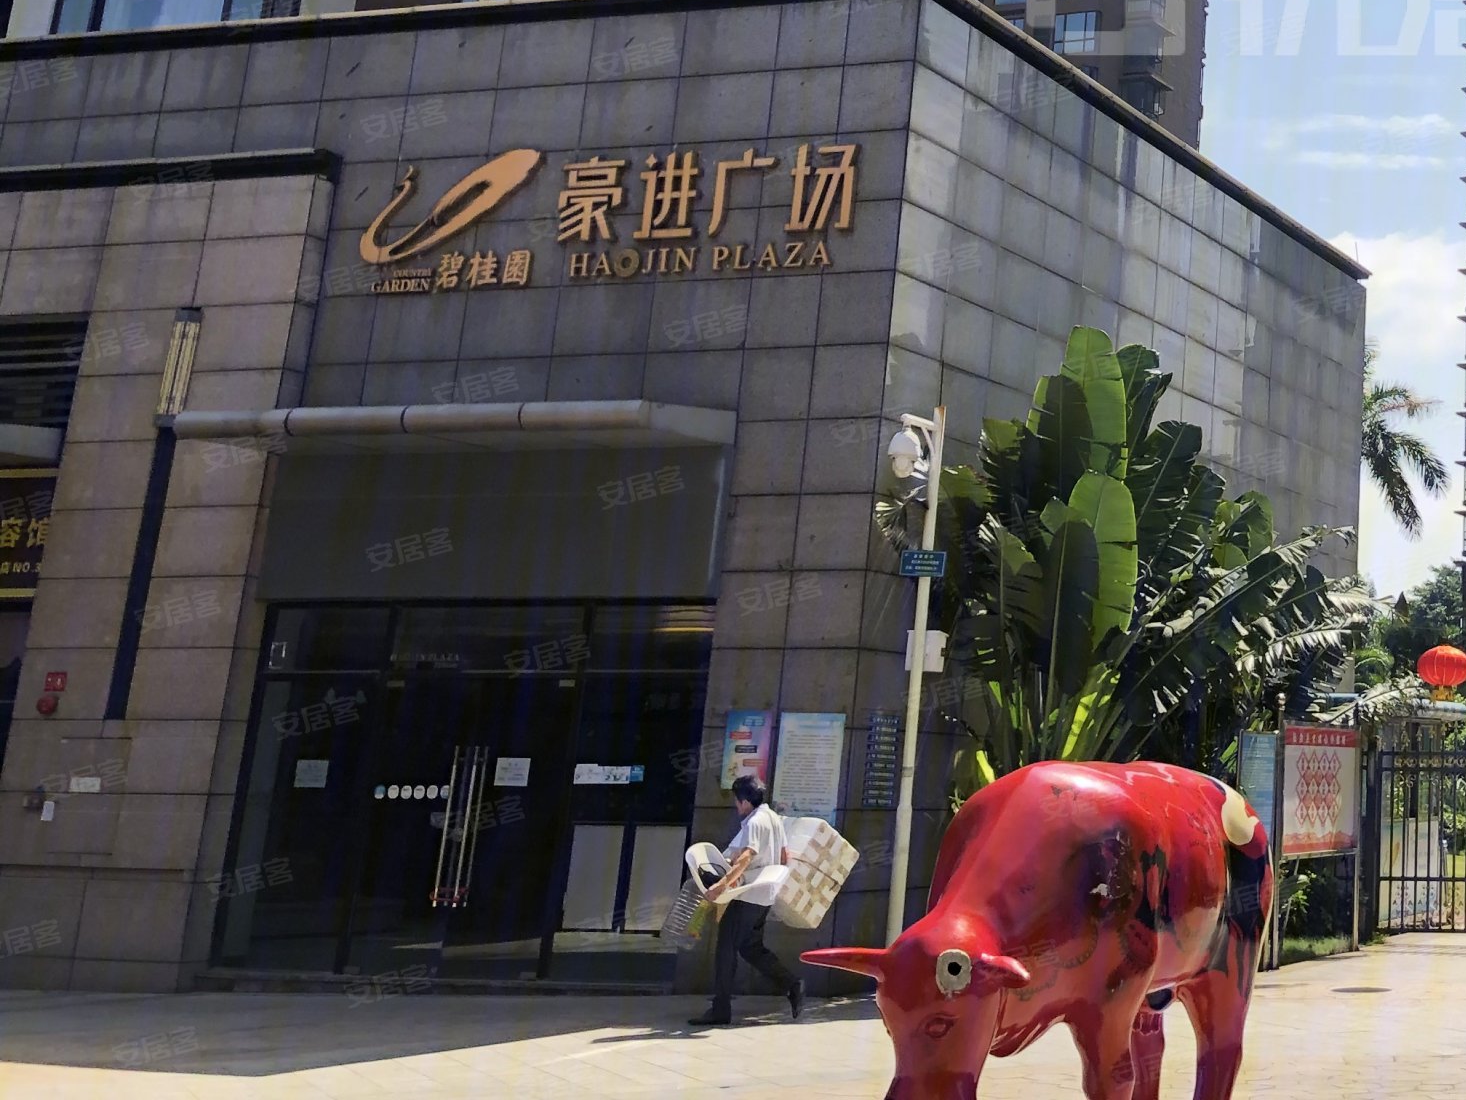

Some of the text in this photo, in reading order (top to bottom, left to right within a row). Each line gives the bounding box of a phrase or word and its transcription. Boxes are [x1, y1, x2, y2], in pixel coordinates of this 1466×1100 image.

[557, 143, 861, 242] 豪进广场
[569, 241, 832, 279] HAOJIN PLAZA
[370, 277, 432, 293] GARDEN
